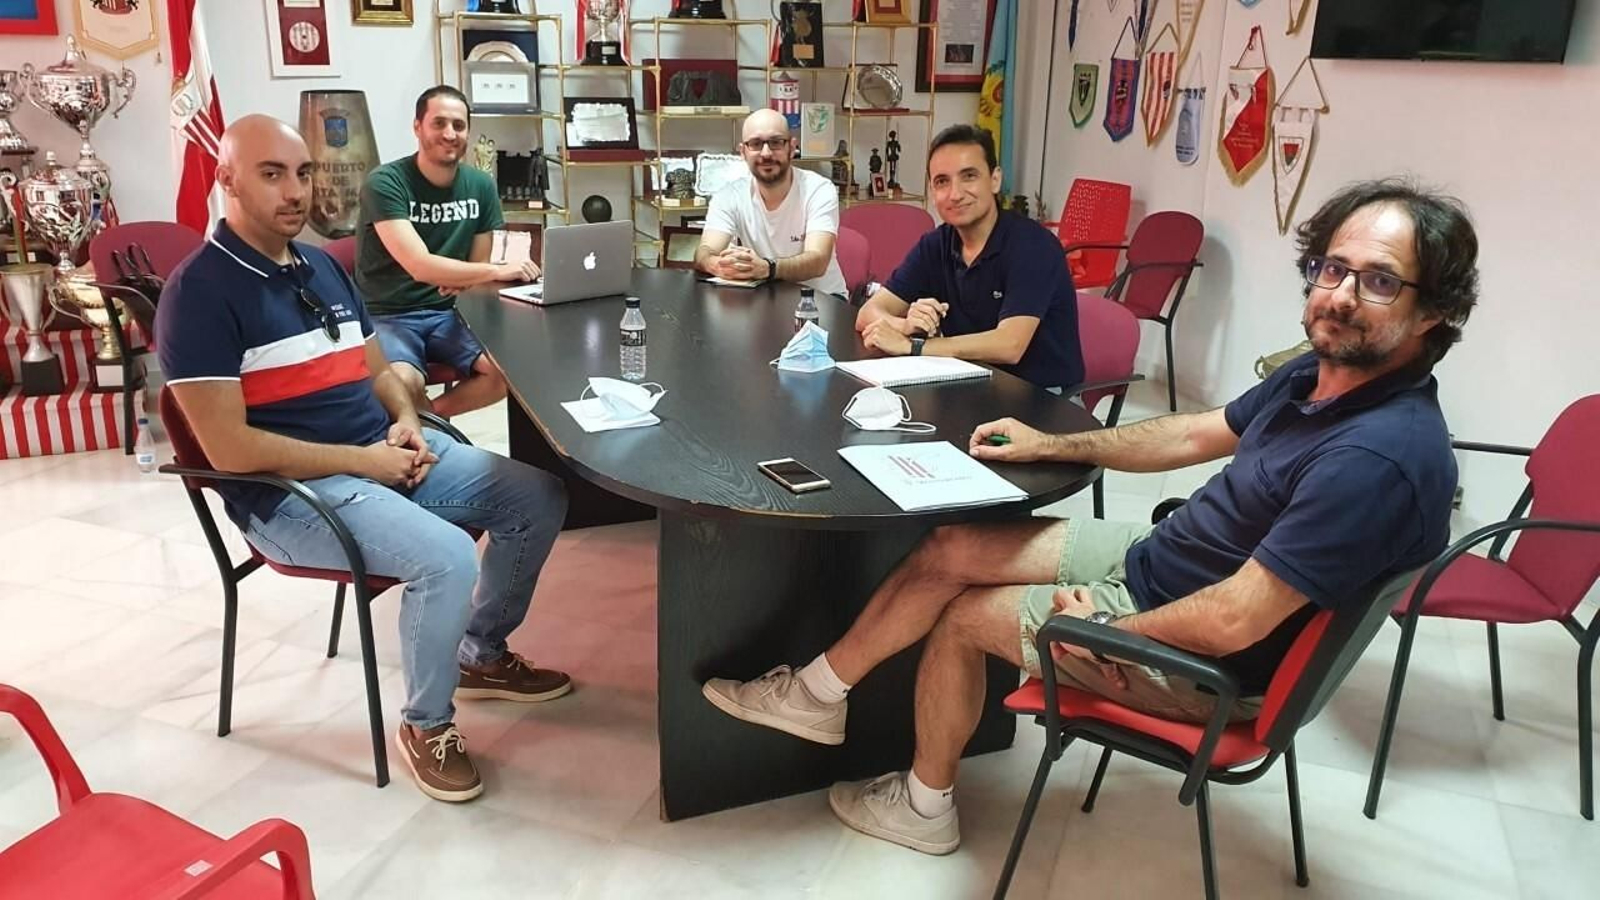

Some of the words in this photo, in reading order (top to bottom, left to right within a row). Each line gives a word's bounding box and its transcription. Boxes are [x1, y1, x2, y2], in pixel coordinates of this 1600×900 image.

[312, 161, 366, 173] PUERTO
[332, 175, 350, 186] DE
[409, 199, 480, 223] LEGEND
